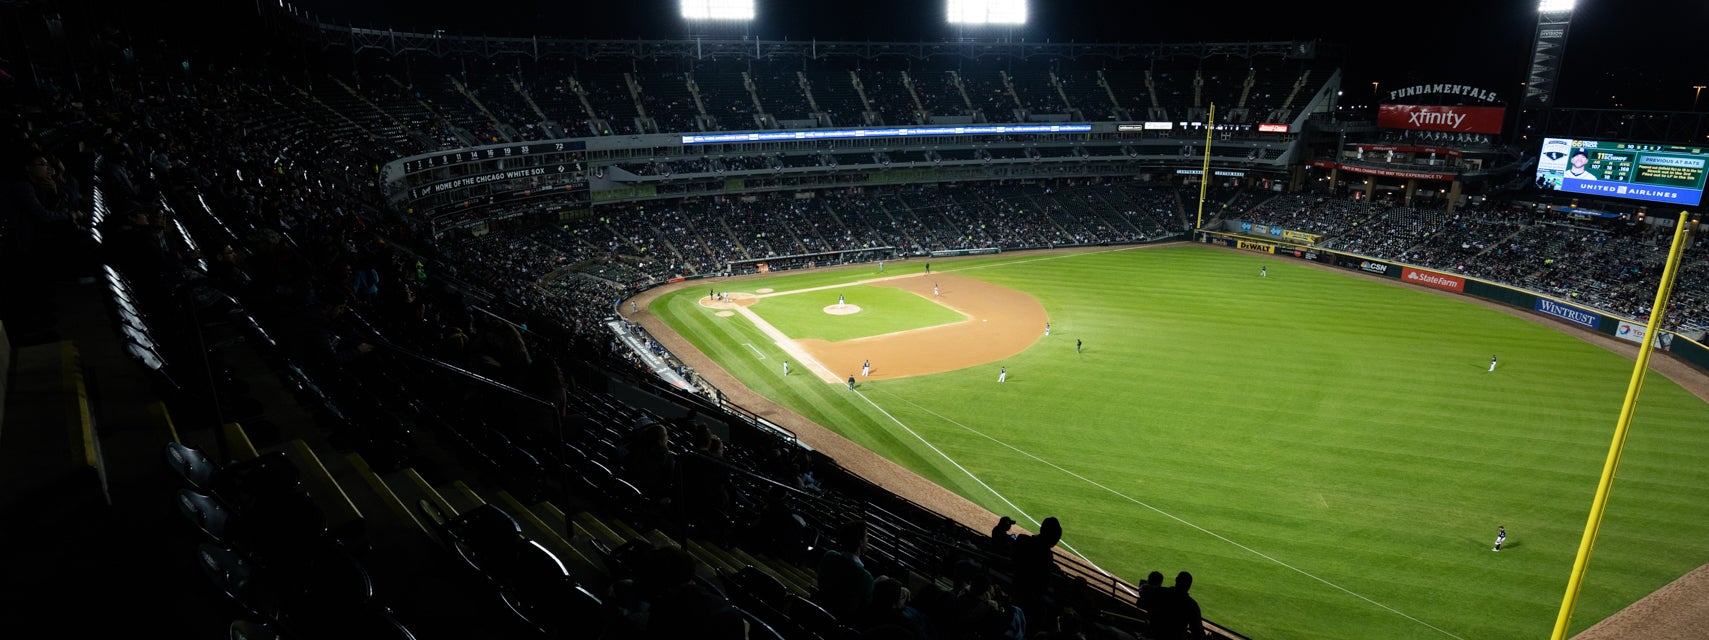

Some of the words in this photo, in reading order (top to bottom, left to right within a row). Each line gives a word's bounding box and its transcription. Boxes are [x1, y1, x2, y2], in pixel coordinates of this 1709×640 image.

[1390, 84, 1496, 102] FUNDAMENTALS
[1408, 109, 1467, 128] xfinity
[435, 182, 453, 192] HOME
[453, 180, 462, 188] OF
[462, 177, 475, 186] THE
[476, 173, 504, 184] CHICAGO
[506, 169, 530, 179] WHITE
[531, 167, 545, 175] SOX
[1580, 183, 1616, 192] UNITED
[1628, 188, 1678, 199] AIRLINES
[1370, 263, 1387, 272] CSN
[1541, 299, 1595, 325] WINTRUST
